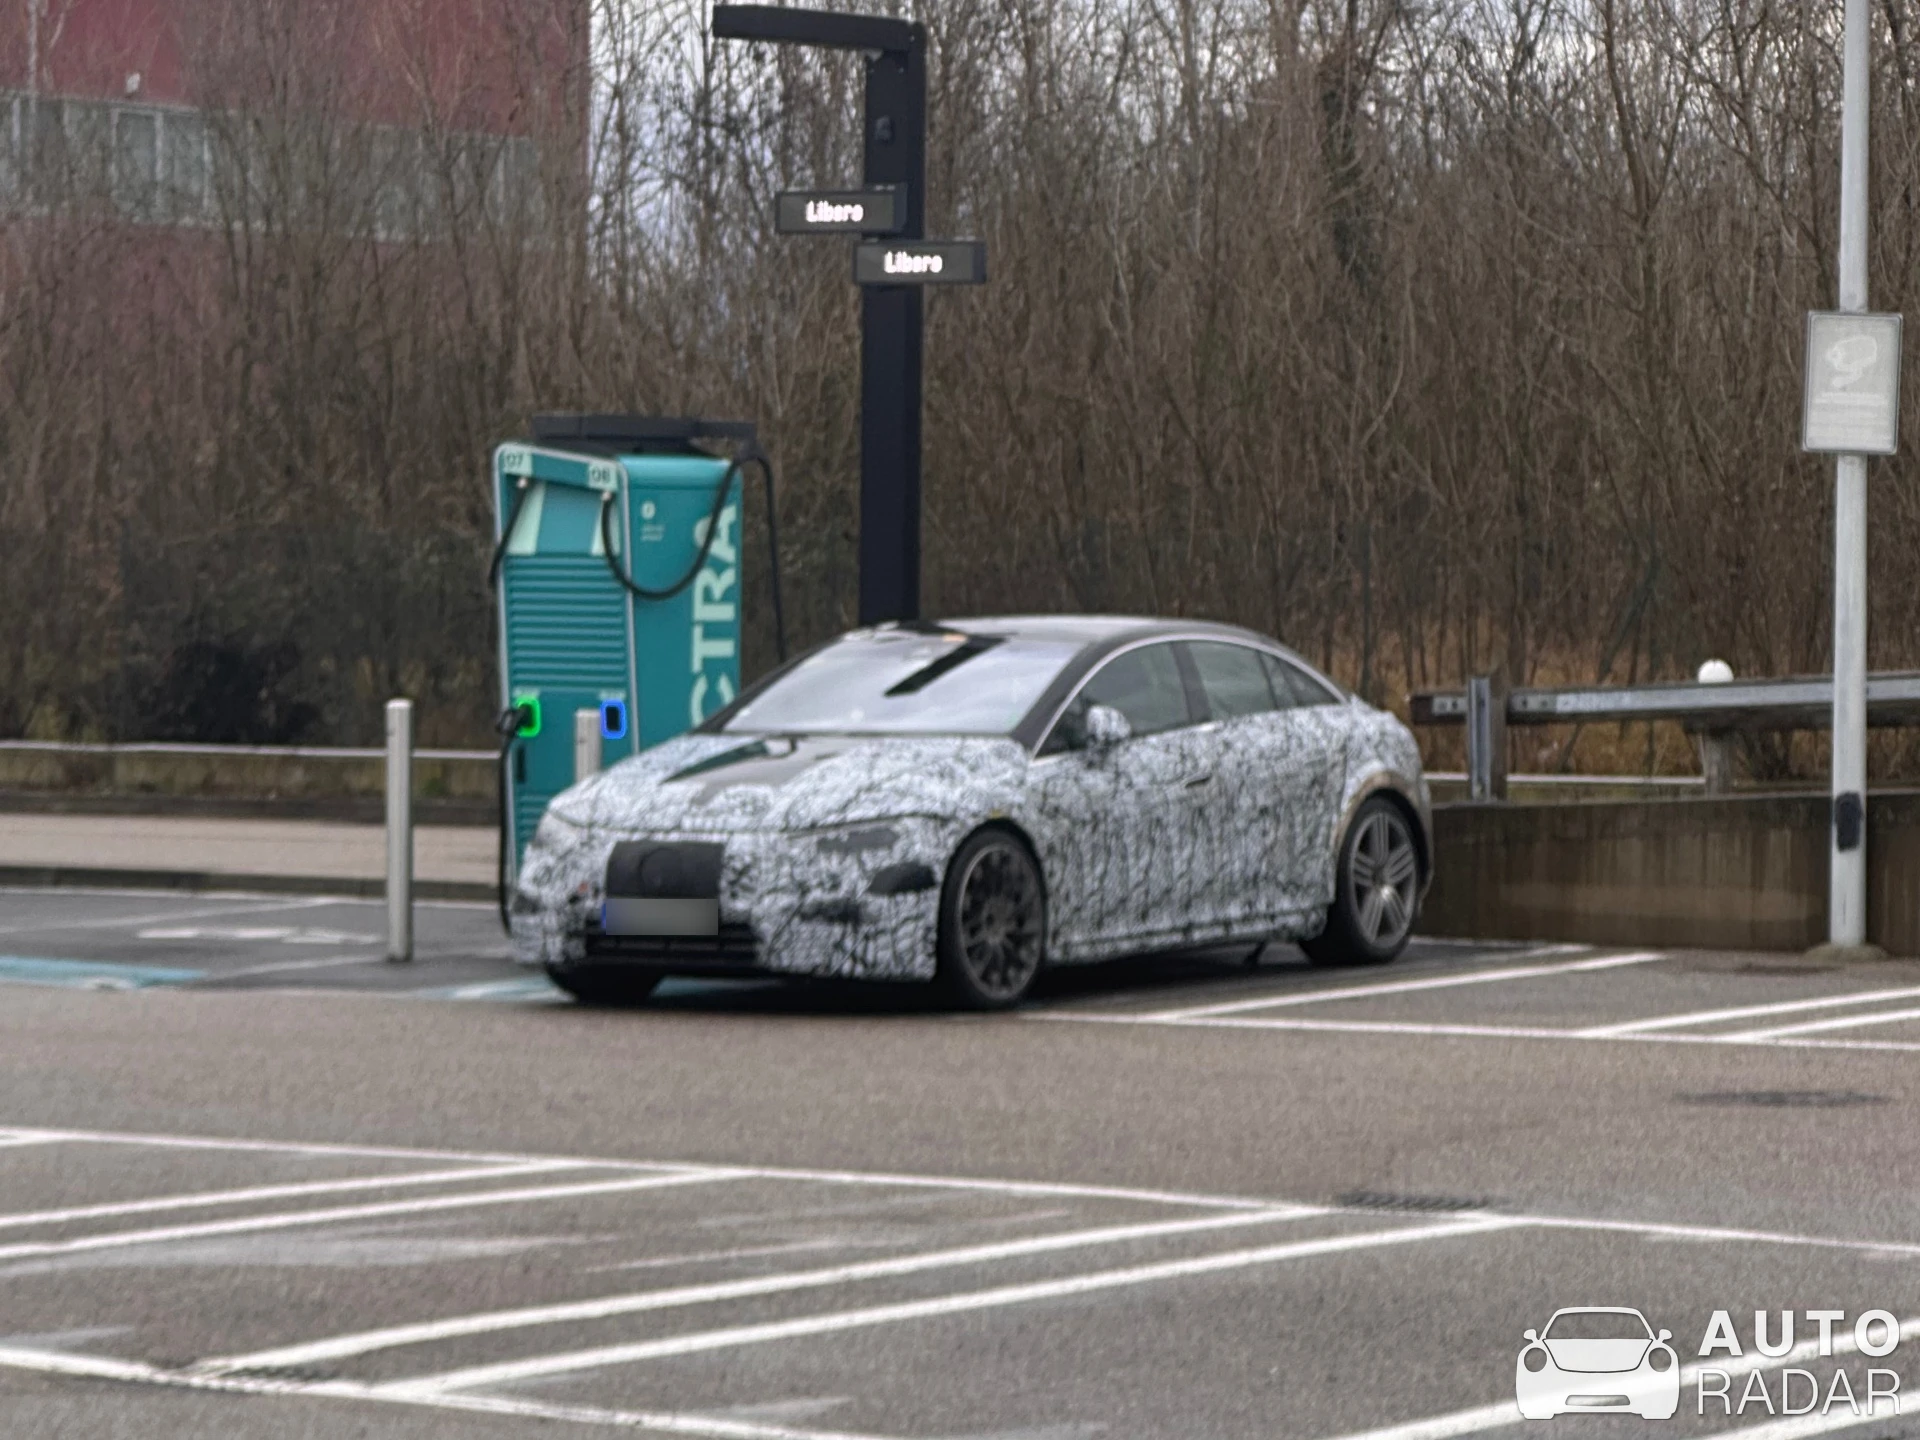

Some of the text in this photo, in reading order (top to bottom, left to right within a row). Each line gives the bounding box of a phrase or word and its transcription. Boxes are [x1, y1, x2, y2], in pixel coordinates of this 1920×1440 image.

[806, 201, 864, 222] Libero
[884, 251, 943, 273] Libero
[505, 451, 525, 468] 07
